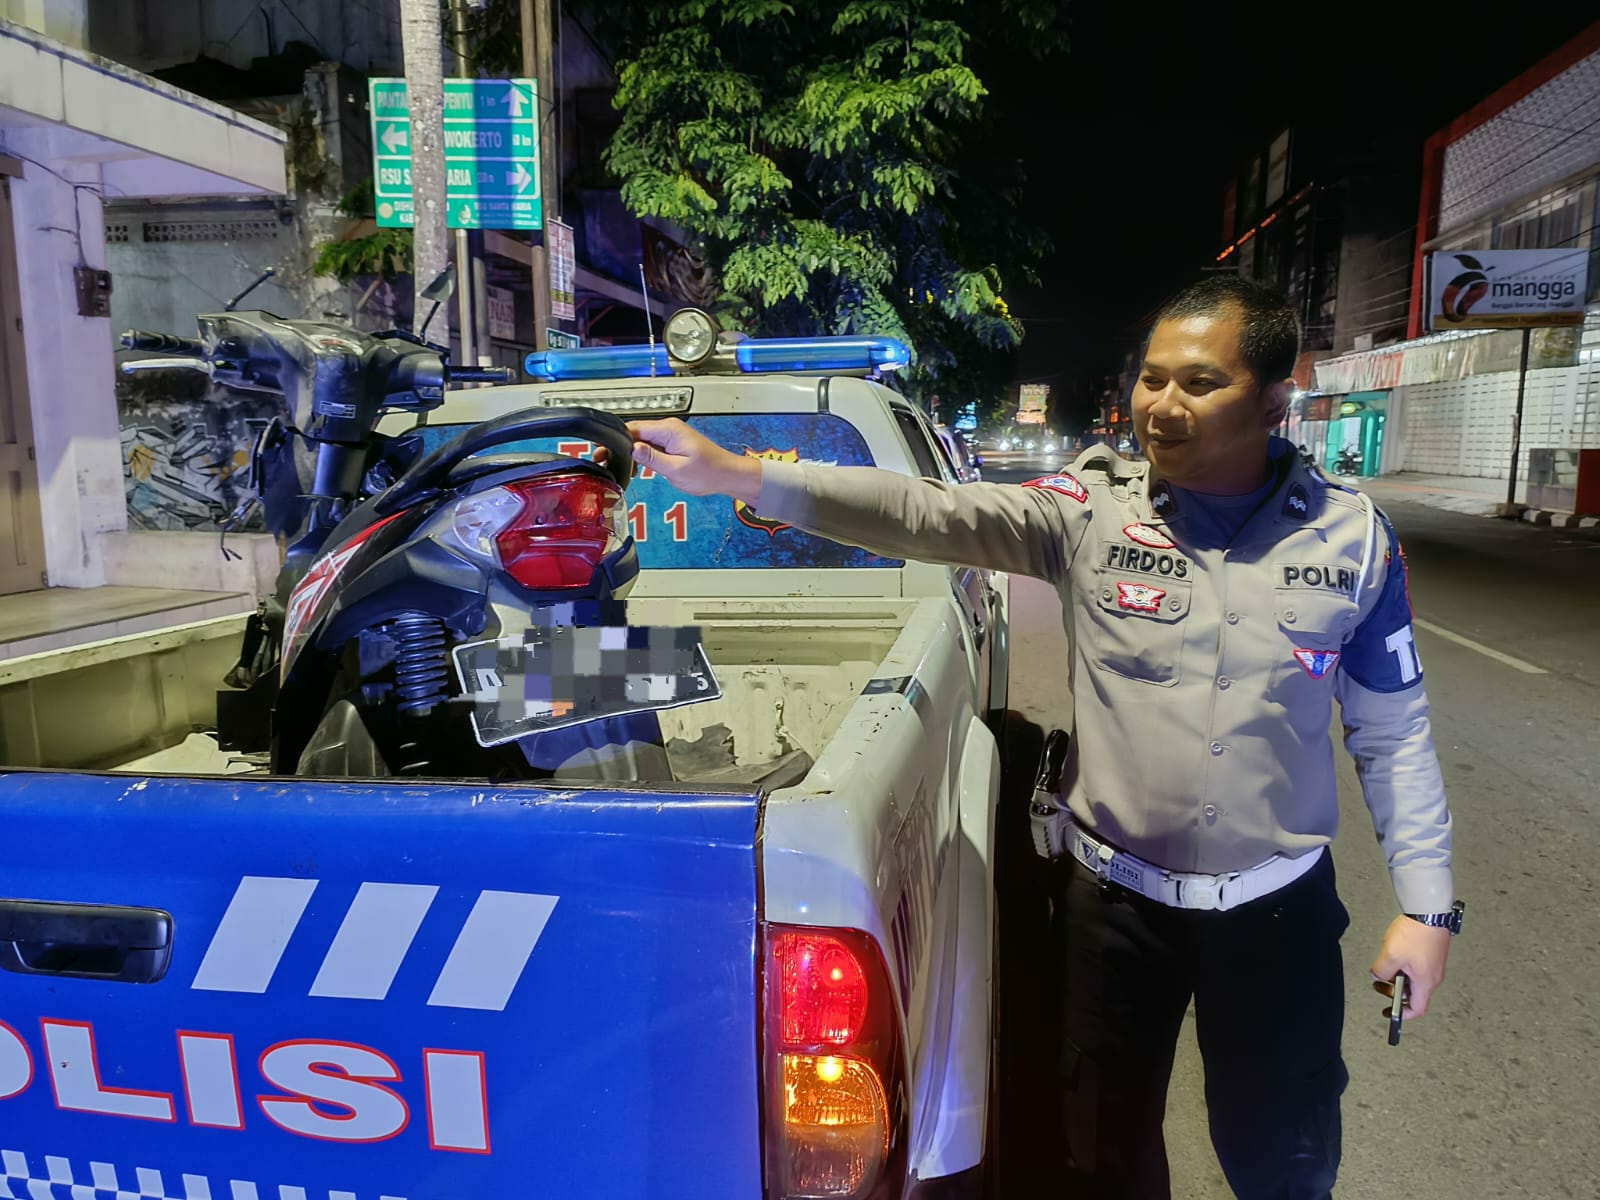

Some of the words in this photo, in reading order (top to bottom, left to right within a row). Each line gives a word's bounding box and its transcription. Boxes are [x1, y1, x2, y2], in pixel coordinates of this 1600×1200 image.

[444, 131, 502, 148] WOKERTO
[381, 168, 401, 184] RSU
[447, 169, 472, 186] ARIA
[1492, 281, 1575, 300] mangga
[1107, 544, 1188, 578] FIRDOS
[1284, 565, 1355, 593] POLRI
